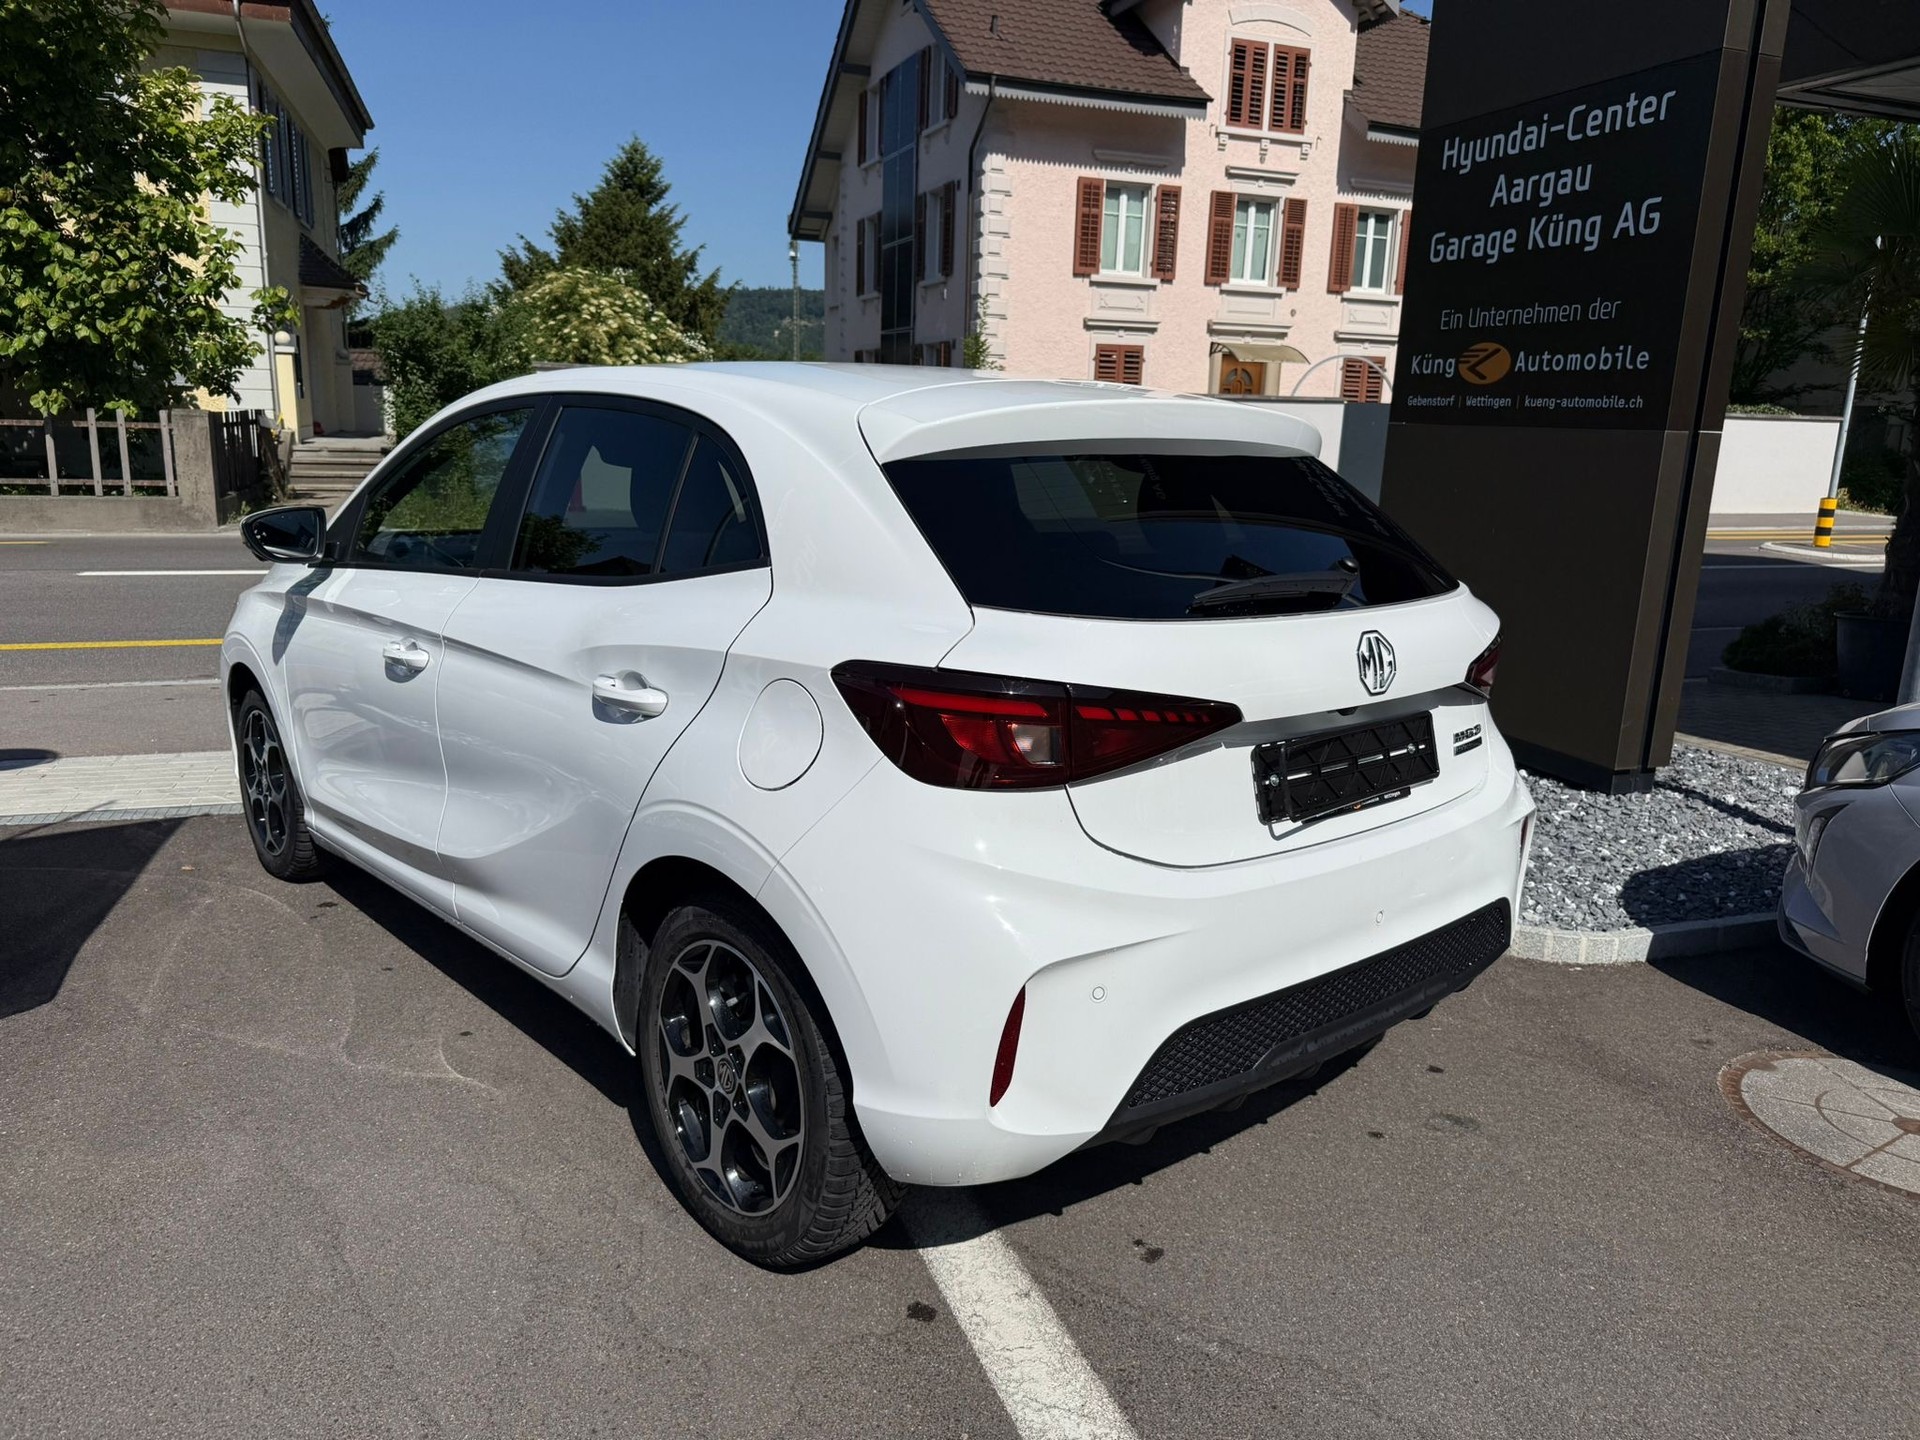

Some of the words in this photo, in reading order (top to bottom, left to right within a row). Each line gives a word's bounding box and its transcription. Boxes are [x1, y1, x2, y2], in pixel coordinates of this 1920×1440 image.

[1442, 90, 1677, 174] Hyundai-Center
[1489, 163, 1593, 208] Aargau
[1429, 228, 1517, 264] Garage
[1527, 213, 1602, 252] Küng
[1612, 196, 1663, 239] AG
[1440, 309, 1463, 330] Ein
[1468, 302, 1582, 328] Unternehmen
[1588, 297, 1622, 320] der
[1410, 353, 1456, 378] Küng
[1514, 344, 1650, 372] Automobile
[1407, 394, 1456, 407] Gebenstorf
[1465, 394, 1512, 409] Wettingen
[1524, 394, 1644, 410] kueng-automobile.ch
[1360, 635, 1393, 691] MG
